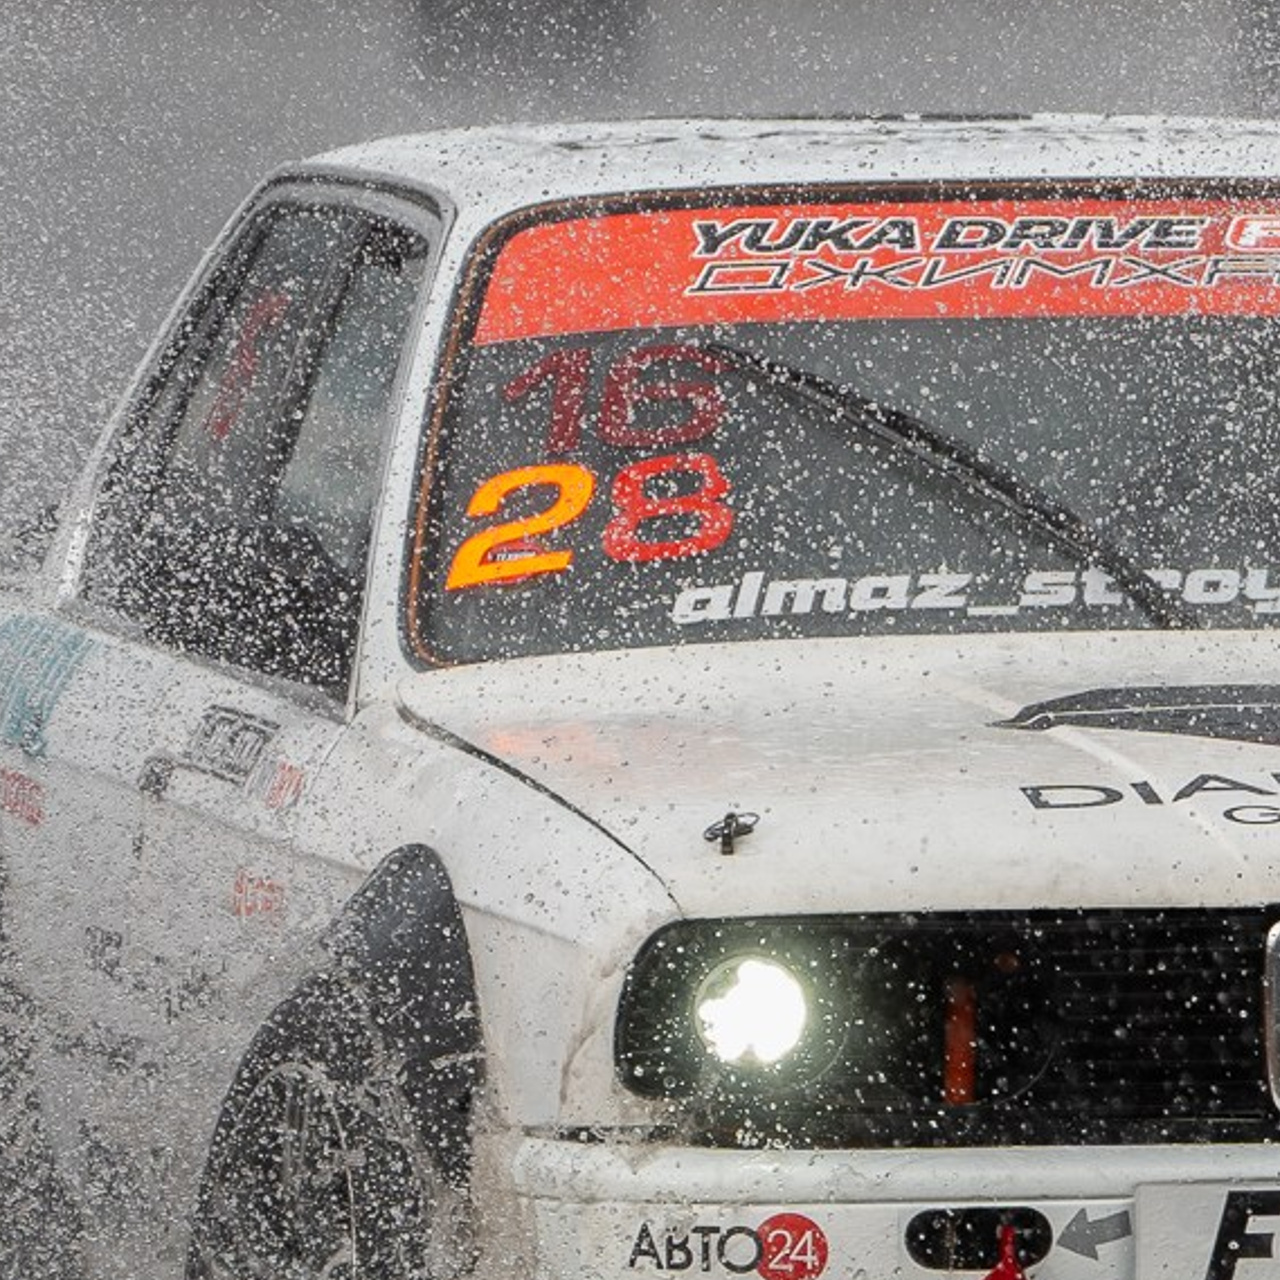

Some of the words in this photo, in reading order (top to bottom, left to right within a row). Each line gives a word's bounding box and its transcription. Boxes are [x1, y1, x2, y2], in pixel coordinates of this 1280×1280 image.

[693, 217, 921, 257] YUKA
[930, 215, 1208, 253] DRIVE
[504, 345, 738, 453] 16
[446, 453, 735, 591] 28
